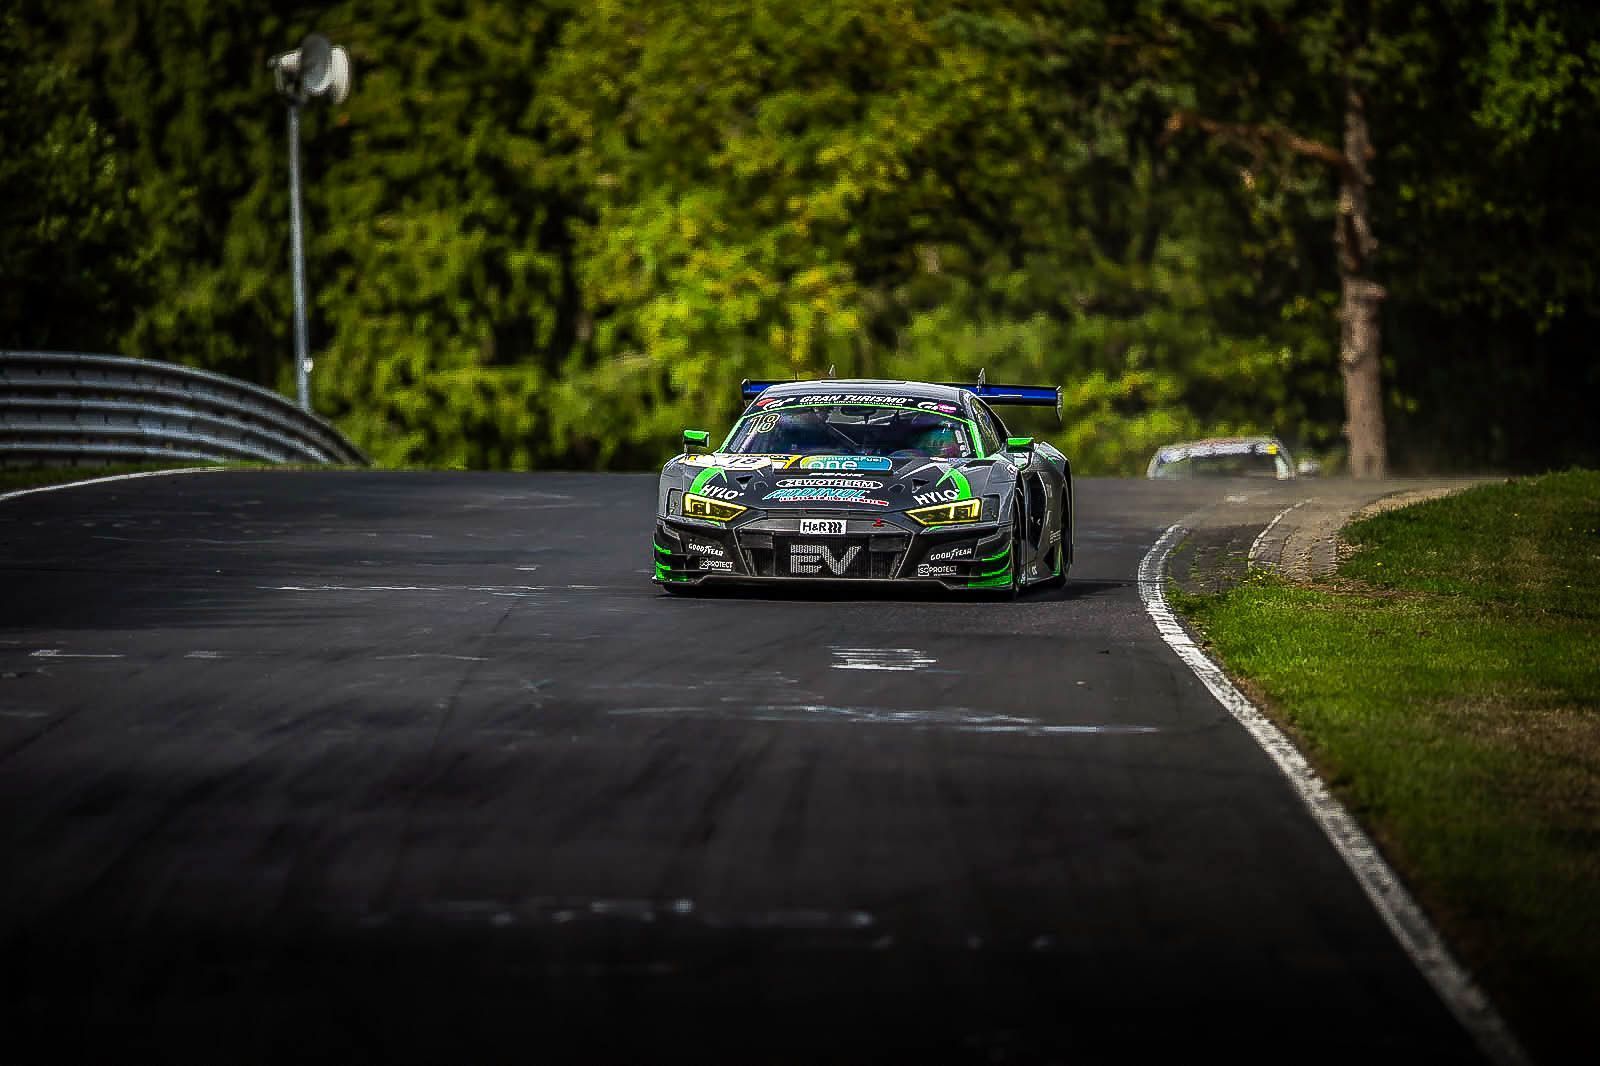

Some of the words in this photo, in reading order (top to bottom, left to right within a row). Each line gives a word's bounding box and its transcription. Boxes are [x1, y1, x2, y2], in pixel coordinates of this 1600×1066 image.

[799, 394, 842, 403] GRAN
[843, 394, 908, 404] TURISMO
[747, 413, 780, 435] 18
[808, 459, 858, 470] one
[702, 484, 739, 500] HYLO
[913, 489, 959, 505] HYLO
[802, 521, 827, 532] H&R
[688, 543, 724, 556] GOODYEAR
[930, 548, 972, 560] GOODYEAR
[929, 565, 957, 573] PROTECT
